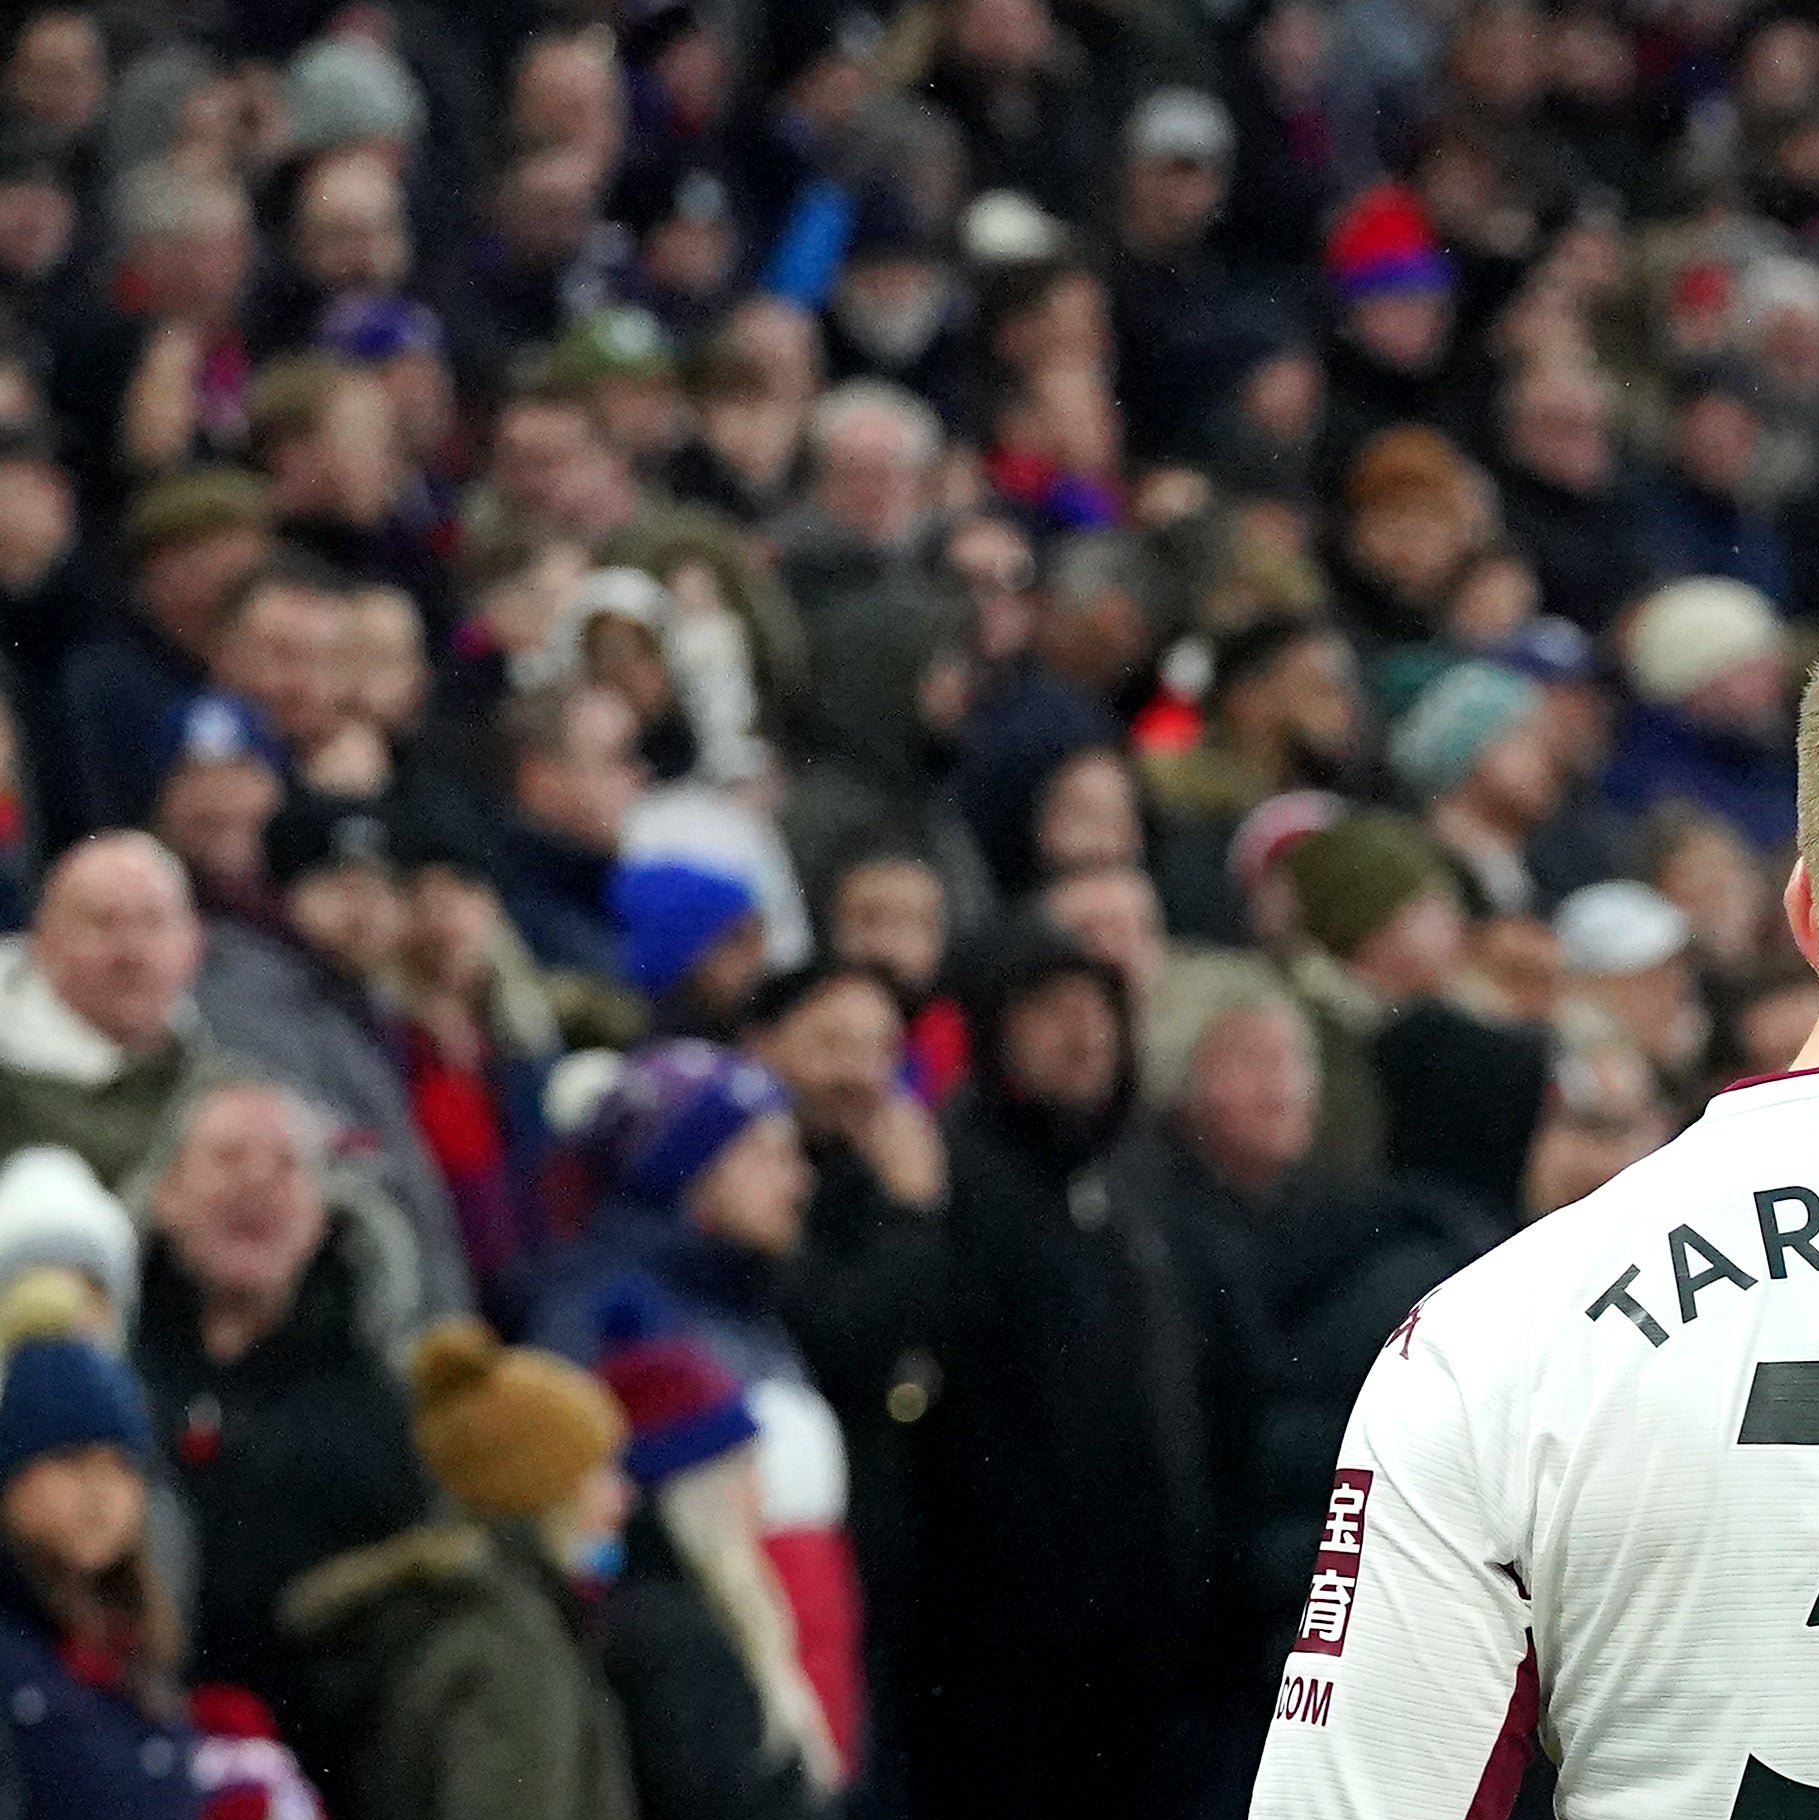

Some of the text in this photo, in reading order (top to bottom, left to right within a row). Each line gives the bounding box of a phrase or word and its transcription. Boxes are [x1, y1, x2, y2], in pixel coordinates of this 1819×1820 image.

[1319, 1481, 1366, 1554] 宝
[1299, 1568, 1356, 1643] 育
[1276, 1675, 1334, 1727] COM
